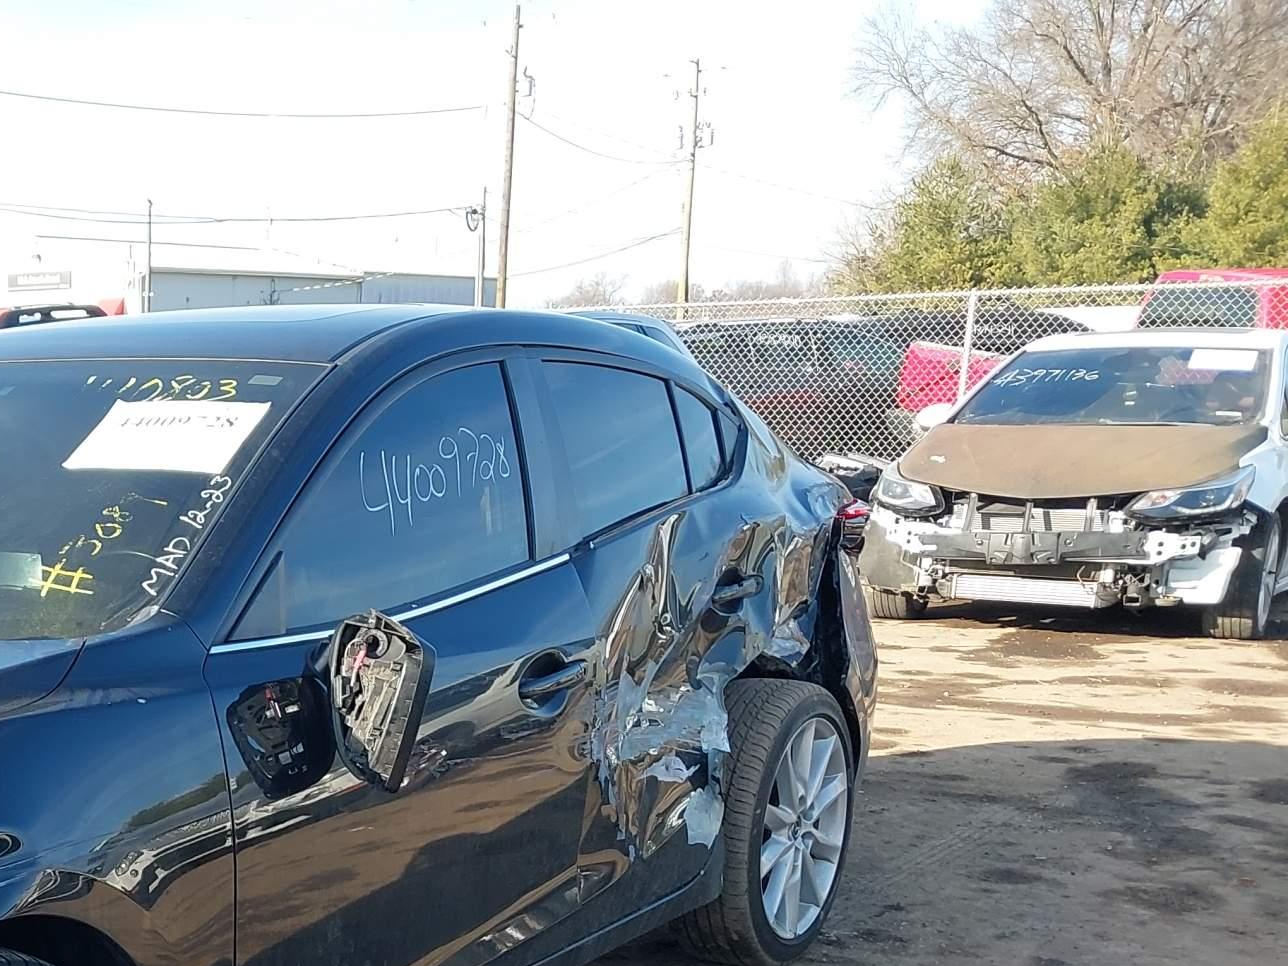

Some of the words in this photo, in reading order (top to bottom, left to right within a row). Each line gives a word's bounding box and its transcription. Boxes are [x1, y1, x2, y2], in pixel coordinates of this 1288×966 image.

[141, 536, 191, 596] MAD
[179, 475, 232, 529] 12-23
[360, 427, 511, 537] 44009728
